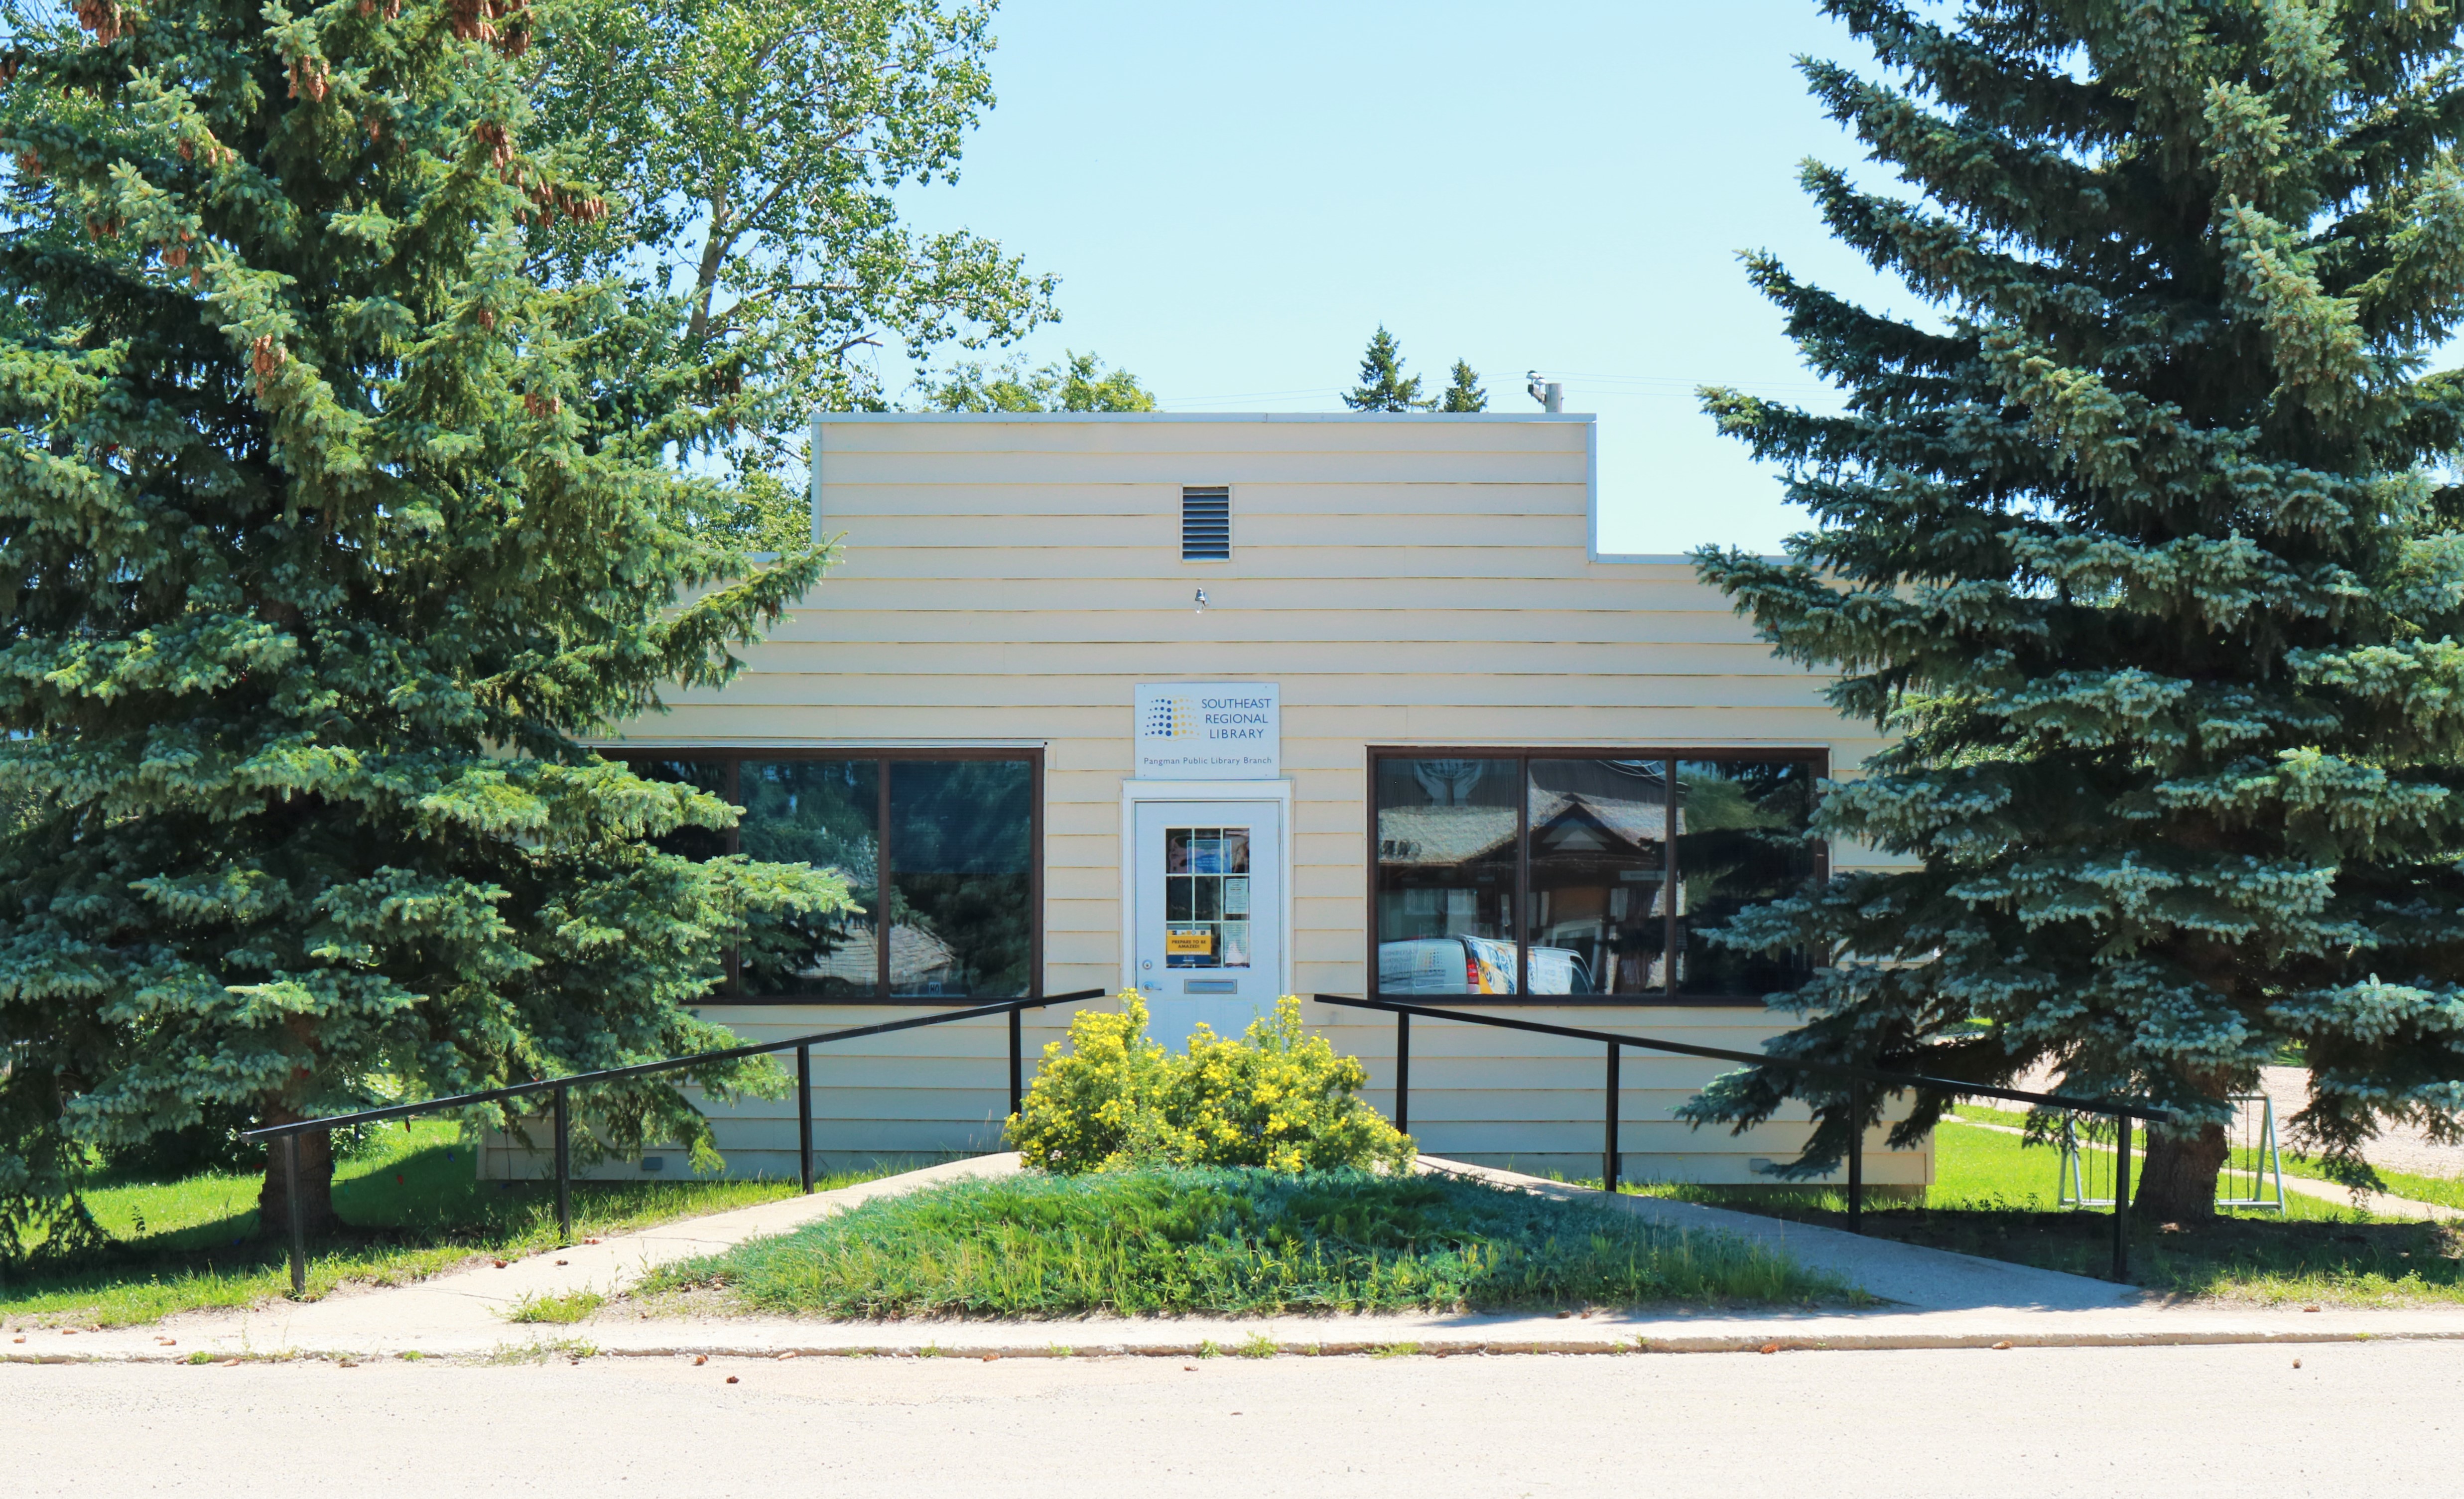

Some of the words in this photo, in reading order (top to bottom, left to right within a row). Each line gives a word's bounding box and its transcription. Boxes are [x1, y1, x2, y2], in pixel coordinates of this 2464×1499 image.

[1201, 698, 1272, 708] SOUTHEAST
[1205, 713, 1269, 724] REGIONAL
[1209, 729, 1264, 739] LIBRARY
[1144, 757, 1180, 766] Pangman
[1211, 757, 1240, 766] Library
